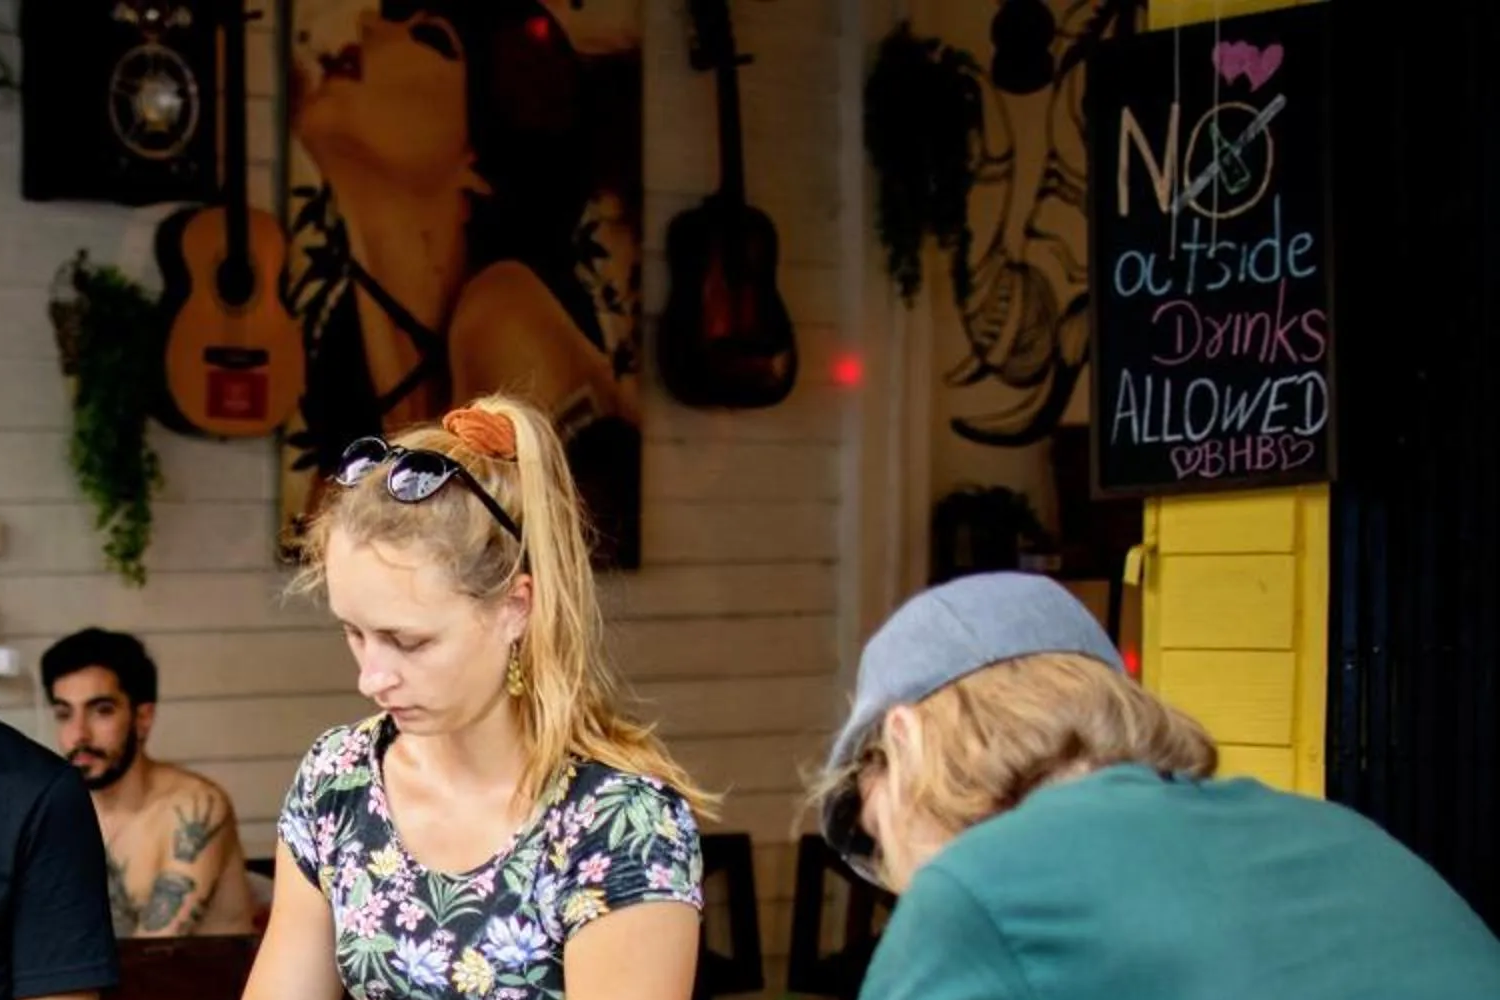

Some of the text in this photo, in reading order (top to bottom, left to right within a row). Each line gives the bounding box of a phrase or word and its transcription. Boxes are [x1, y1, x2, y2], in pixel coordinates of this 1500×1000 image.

[1117, 101, 1273, 219] NO
[1115, 194, 1316, 297] outside
[1152, 278, 1327, 365] Drinks
[1112, 369, 1328, 443] ALLOWED
[1199, 434, 1277, 477] BHB
